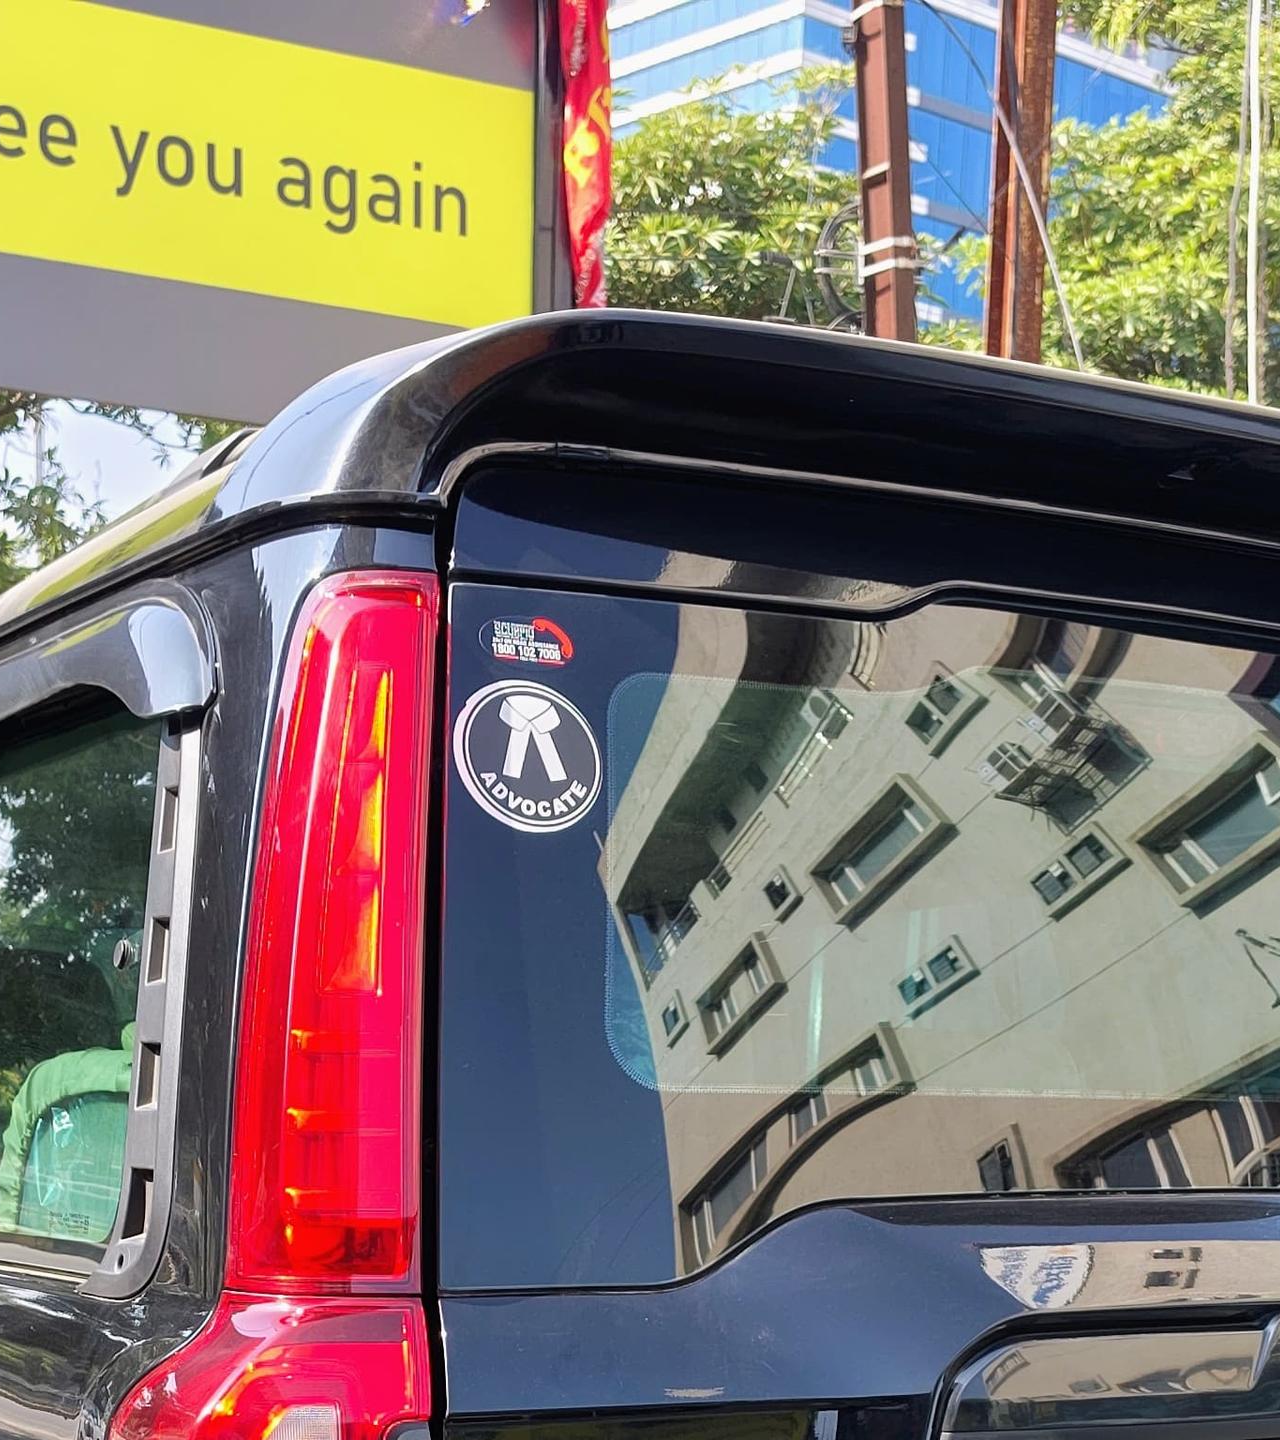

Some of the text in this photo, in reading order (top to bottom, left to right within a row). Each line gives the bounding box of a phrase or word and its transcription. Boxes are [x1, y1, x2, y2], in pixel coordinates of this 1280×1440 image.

[109, 122, 244, 198] you
[276, 154, 470, 237] again
[492, 642, 516, 656] 1800
[517, 645, 537, 658] 102
[480, 770, 588, 817] ADVOCATE
